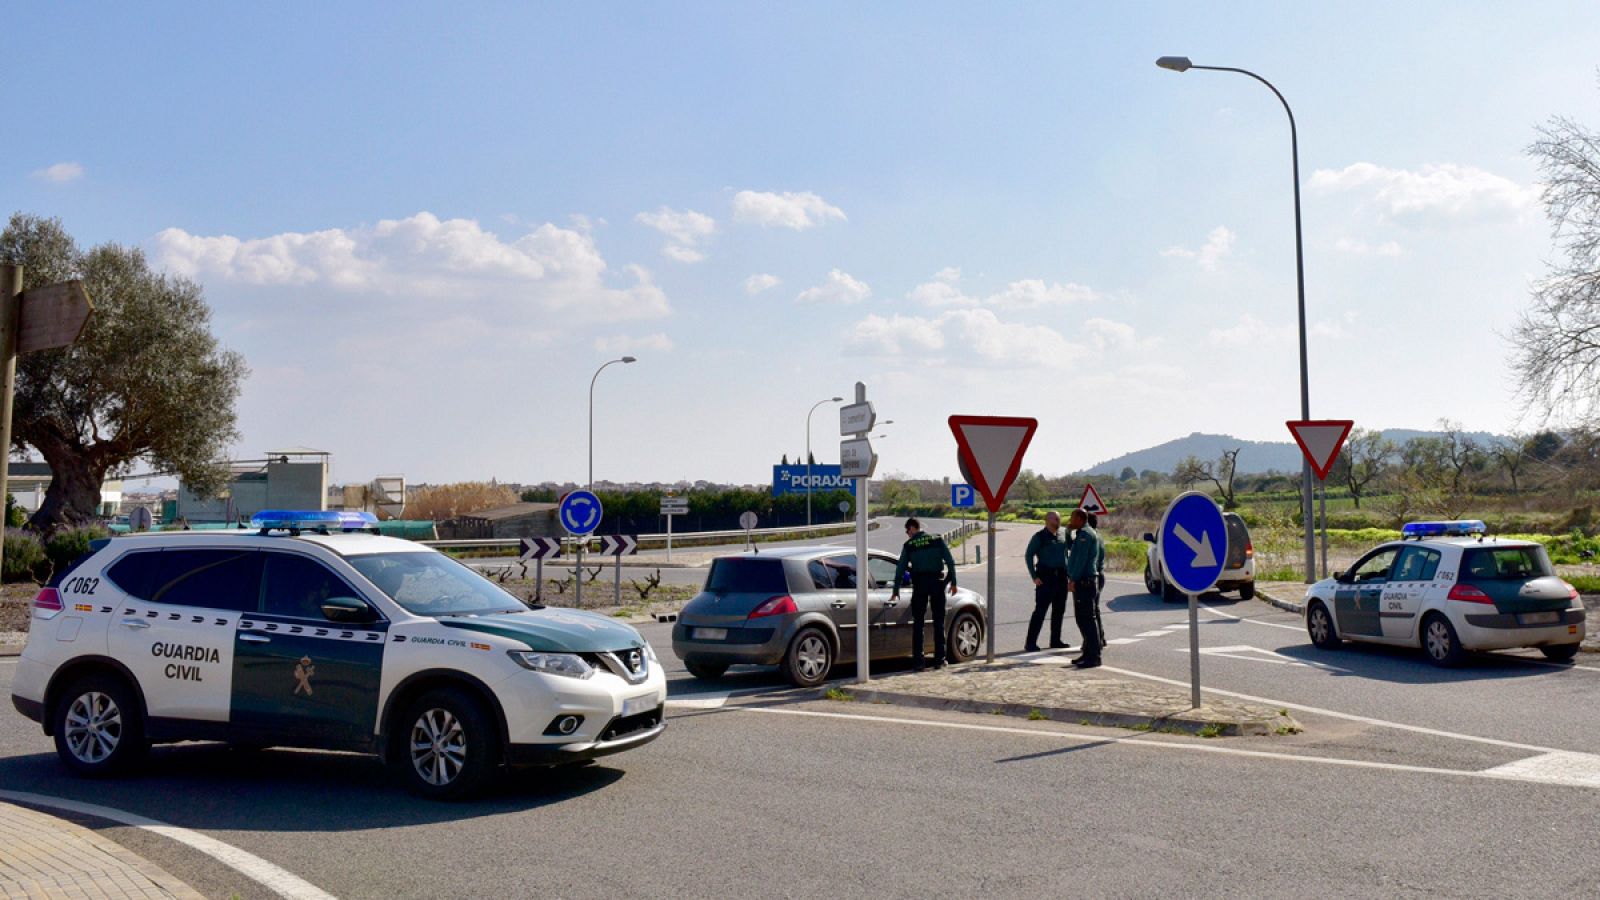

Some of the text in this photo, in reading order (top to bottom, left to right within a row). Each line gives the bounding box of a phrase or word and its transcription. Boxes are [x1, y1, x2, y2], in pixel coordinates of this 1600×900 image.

[792, 475, 852, 487] PORAXA
[956, 487, 970, 505] P
[73, 577, 99, 595] 062
[1383, 592, 1408, 600] GUARDIA
[1388, 602, 1403, 610] CIVIL
[411, 636, 466, 647] GUARDIA CIVIL
[152, 642, 220, 663] GUARDIA
[164, 664, 203, 682] CIVIL
